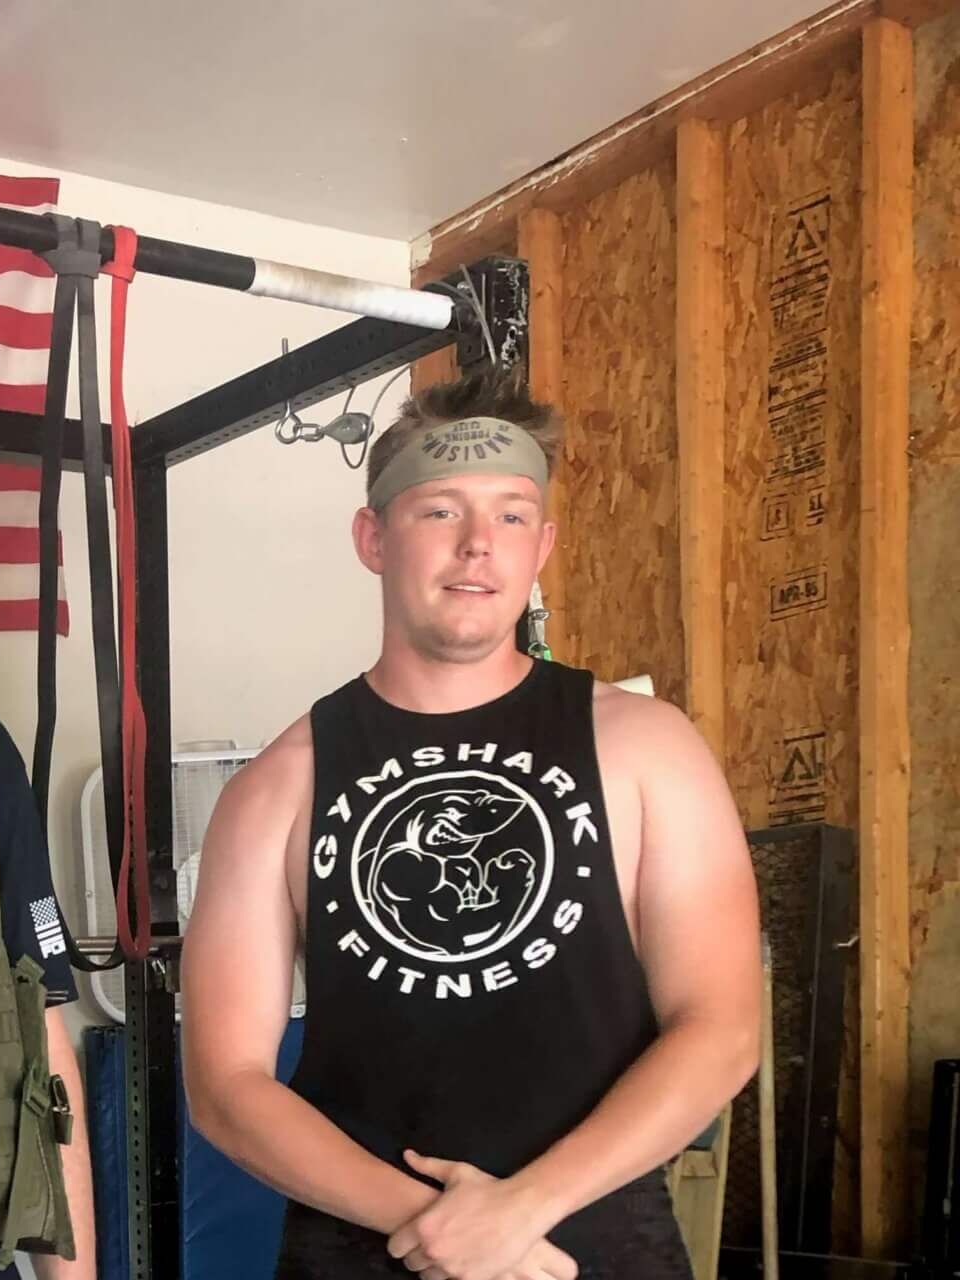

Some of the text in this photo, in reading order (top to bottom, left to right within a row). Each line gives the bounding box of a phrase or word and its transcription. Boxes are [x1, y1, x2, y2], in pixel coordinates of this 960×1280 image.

[422, 431, 513, 462] MADISON
[313, 743, 598, 879] GYMSHARK
[338, 900, 583, 999] FITNESS
